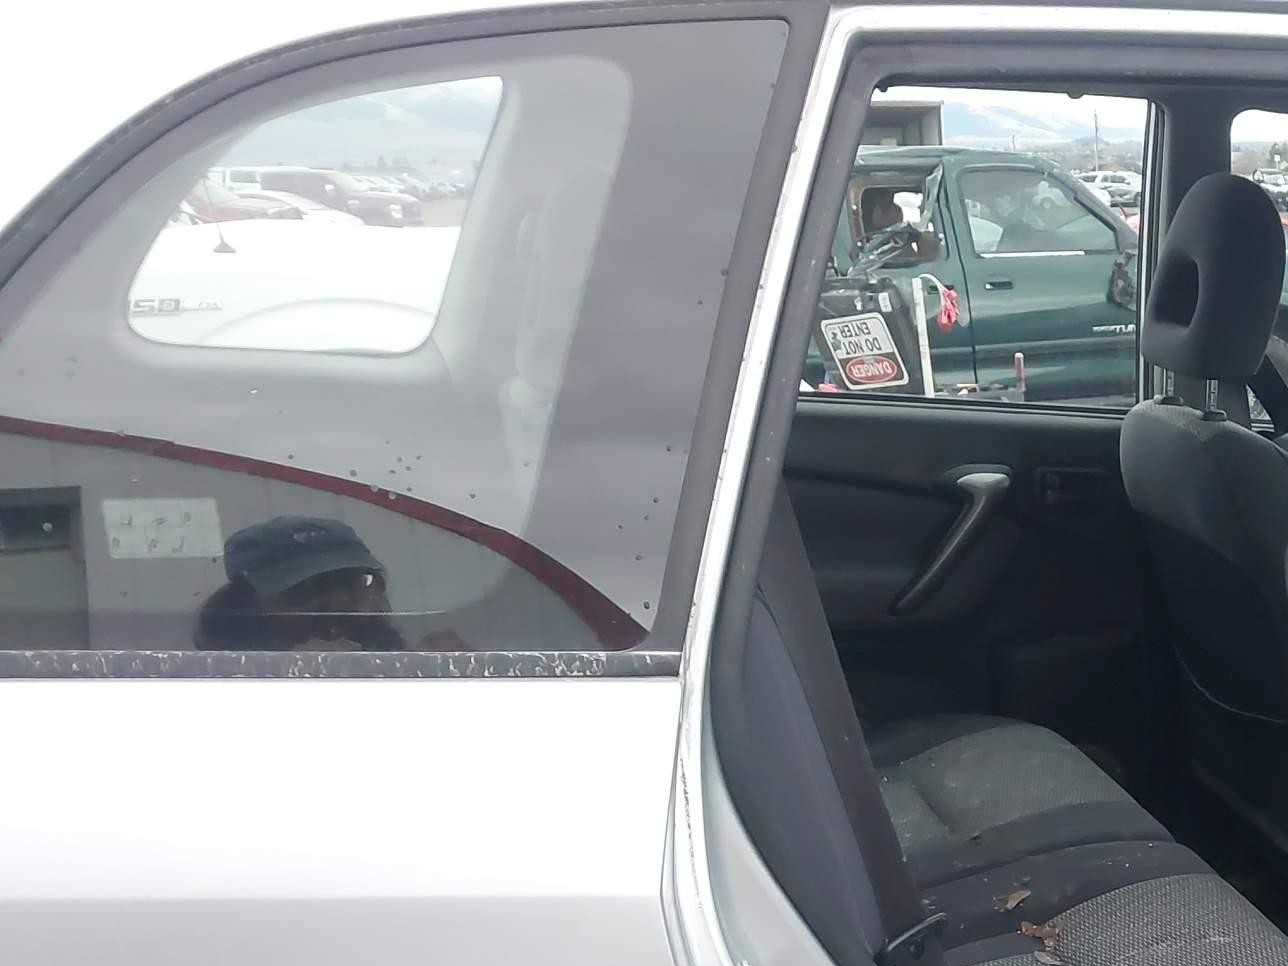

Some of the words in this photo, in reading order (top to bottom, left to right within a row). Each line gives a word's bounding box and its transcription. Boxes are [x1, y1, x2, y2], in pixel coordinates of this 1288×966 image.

[838, 322, 871, 338] ENTER
[843, 339, 864, 355] NOT
[865, 337, 882, 352] DO
[850, 361, 892, 377] DANGER
